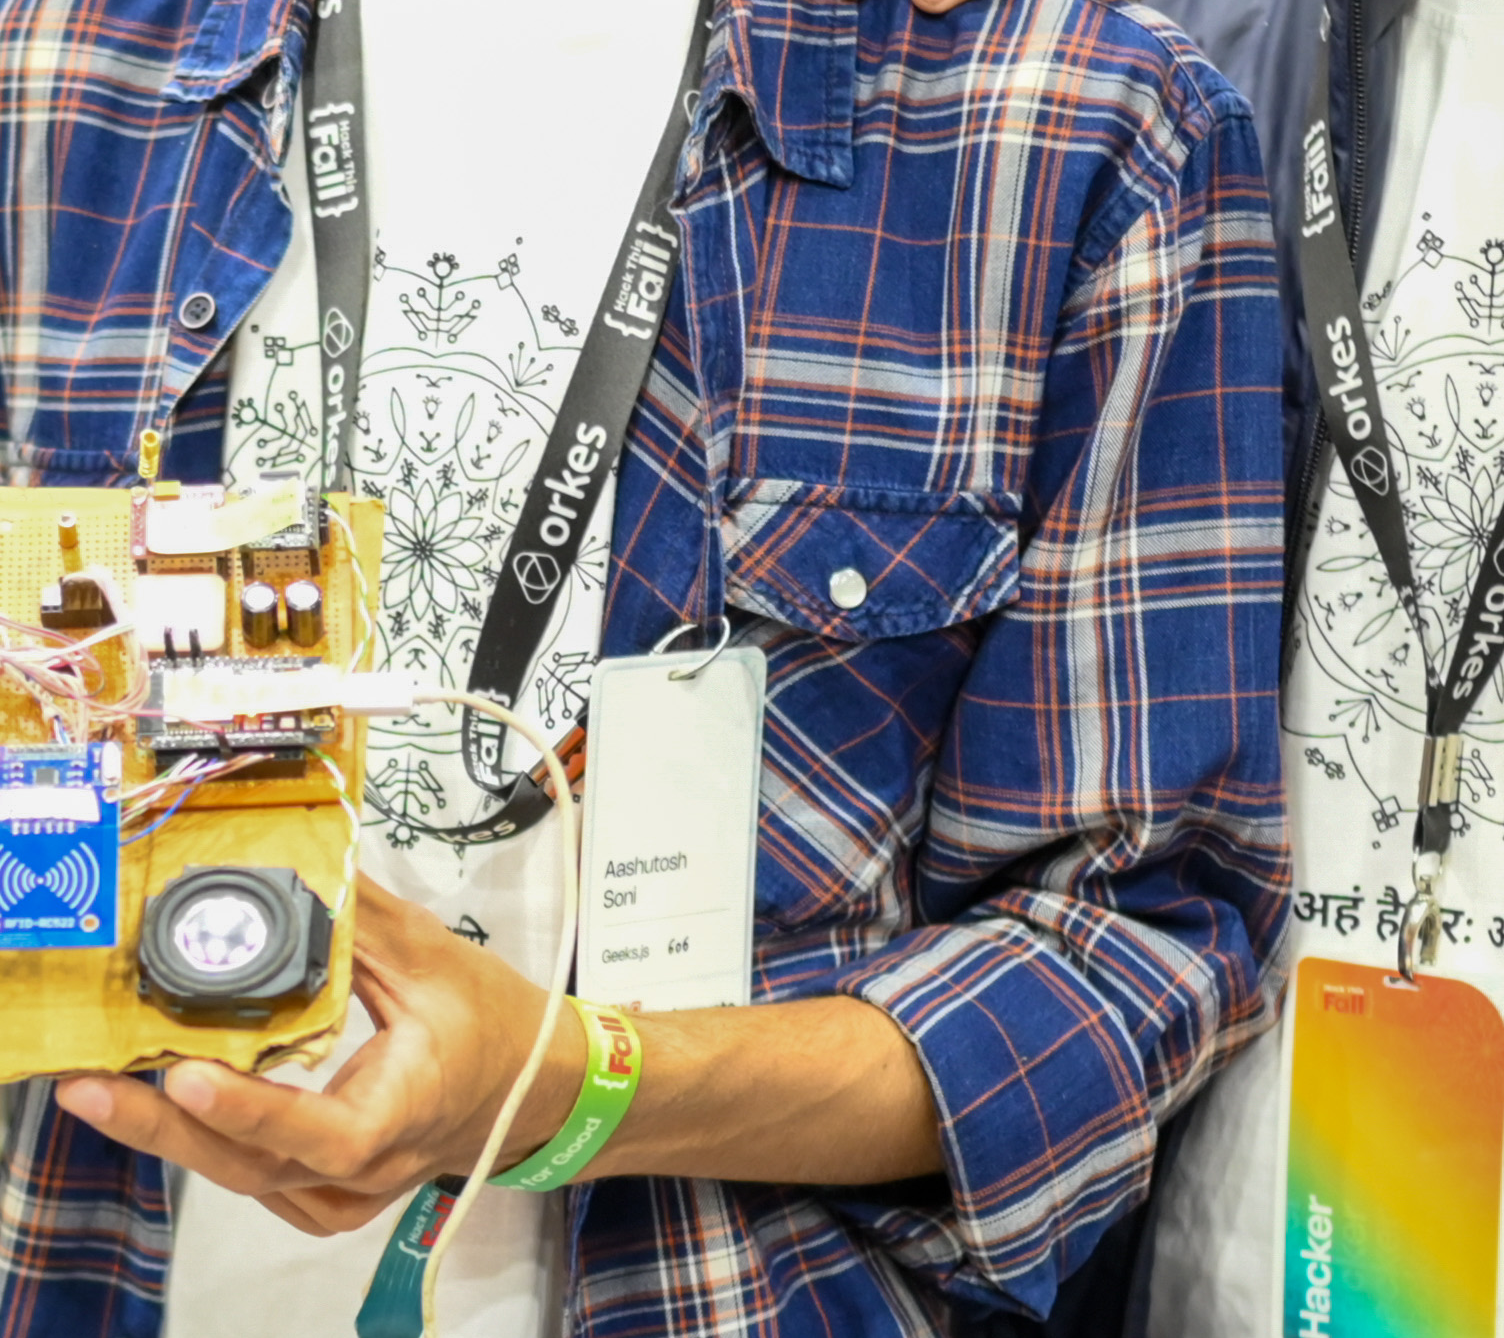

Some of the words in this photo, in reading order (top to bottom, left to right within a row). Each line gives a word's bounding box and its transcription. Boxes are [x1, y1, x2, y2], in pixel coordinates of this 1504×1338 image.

[613, 271, 635, 313] Hack
[1327, 316, 1373, 441] orkes
[324, 364, 346, 488] orkes
[539, 422, 607, 546] orkes
[605, 851, 688, 879] Aashutosh
[603, 886, 637, 909] Soni
[1293, 885, 1365, 936] अहं
[668, 935, 689, 955] 606
[1323, 993, 1366, 1016] Fall
[521, 1167, 551, 1188] for
[551, 1117, 603, 1165] Good
